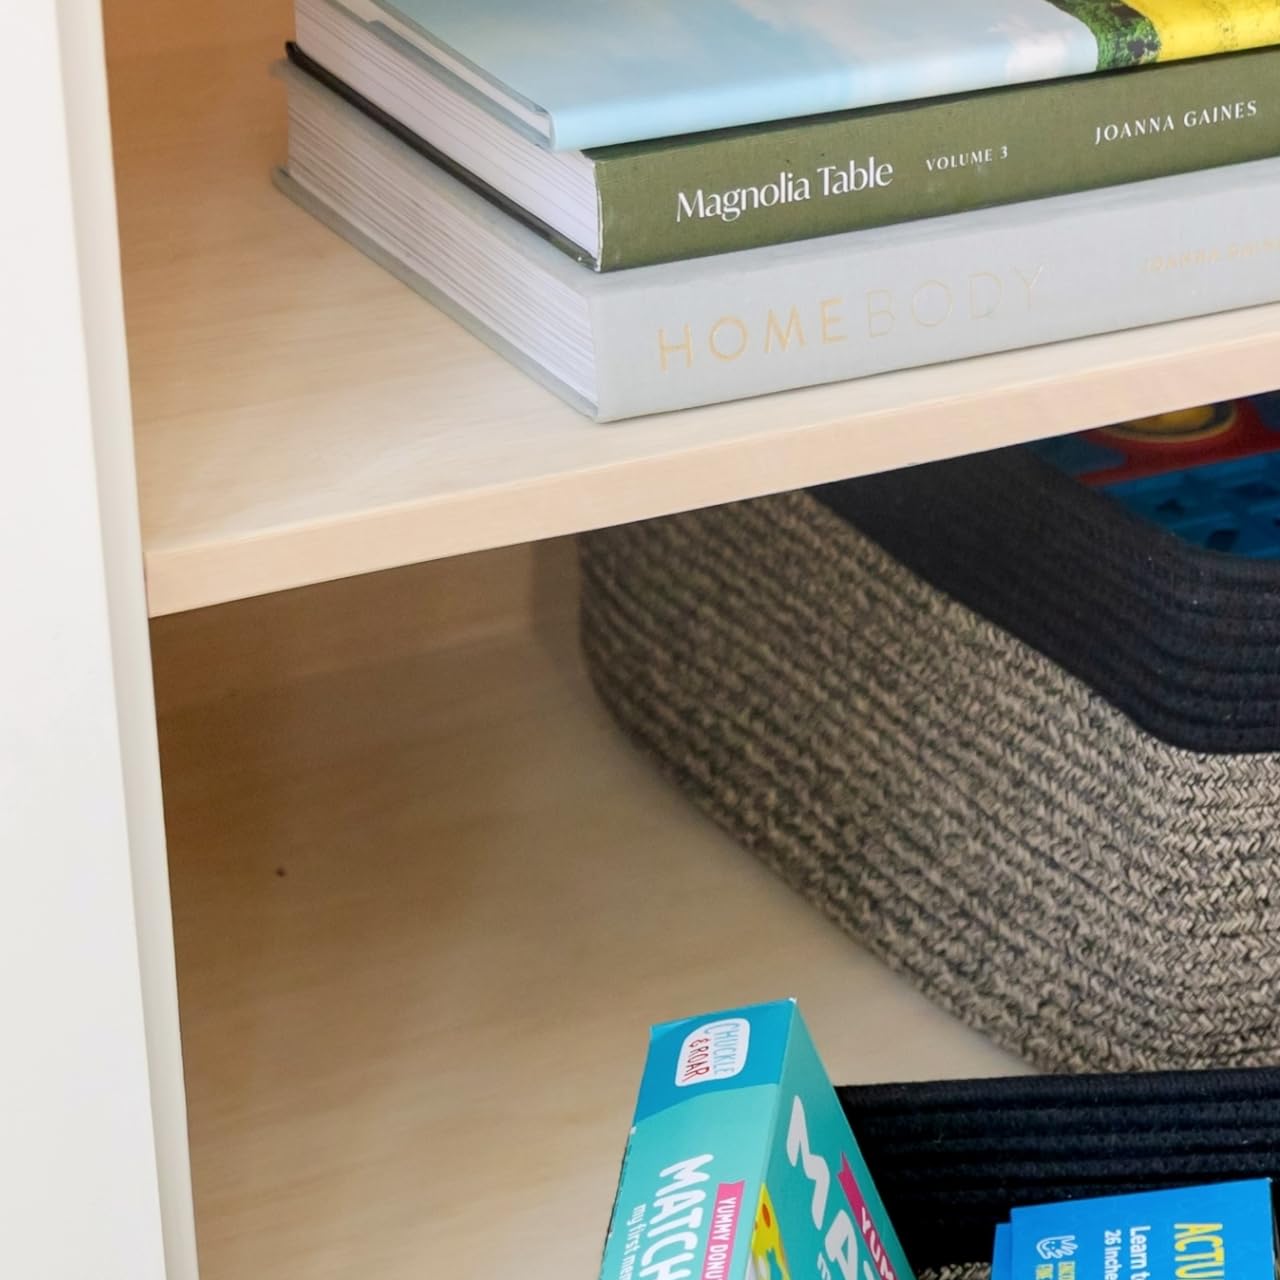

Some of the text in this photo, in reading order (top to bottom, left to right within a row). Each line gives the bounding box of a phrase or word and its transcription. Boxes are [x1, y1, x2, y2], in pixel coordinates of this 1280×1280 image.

[1095, 100, 1257, 145] JOANNA GAINES
[926, 145, 1008, 172] VOLUME 3
[676, 156, 894, 223] Magnolia Table
[657, 265, 1043, 371] HOMEBODY
[704, 1023, 740, 1075] CHUCKLE
[626, 1203, 647, 1227] my
[712, 1197, 737, 1242] YUMMY
[1104, 1229, 1121, 1246] 26
[623, 1222, 646, 1255] first
[1129, 1225, 1151, 1270] Learn
